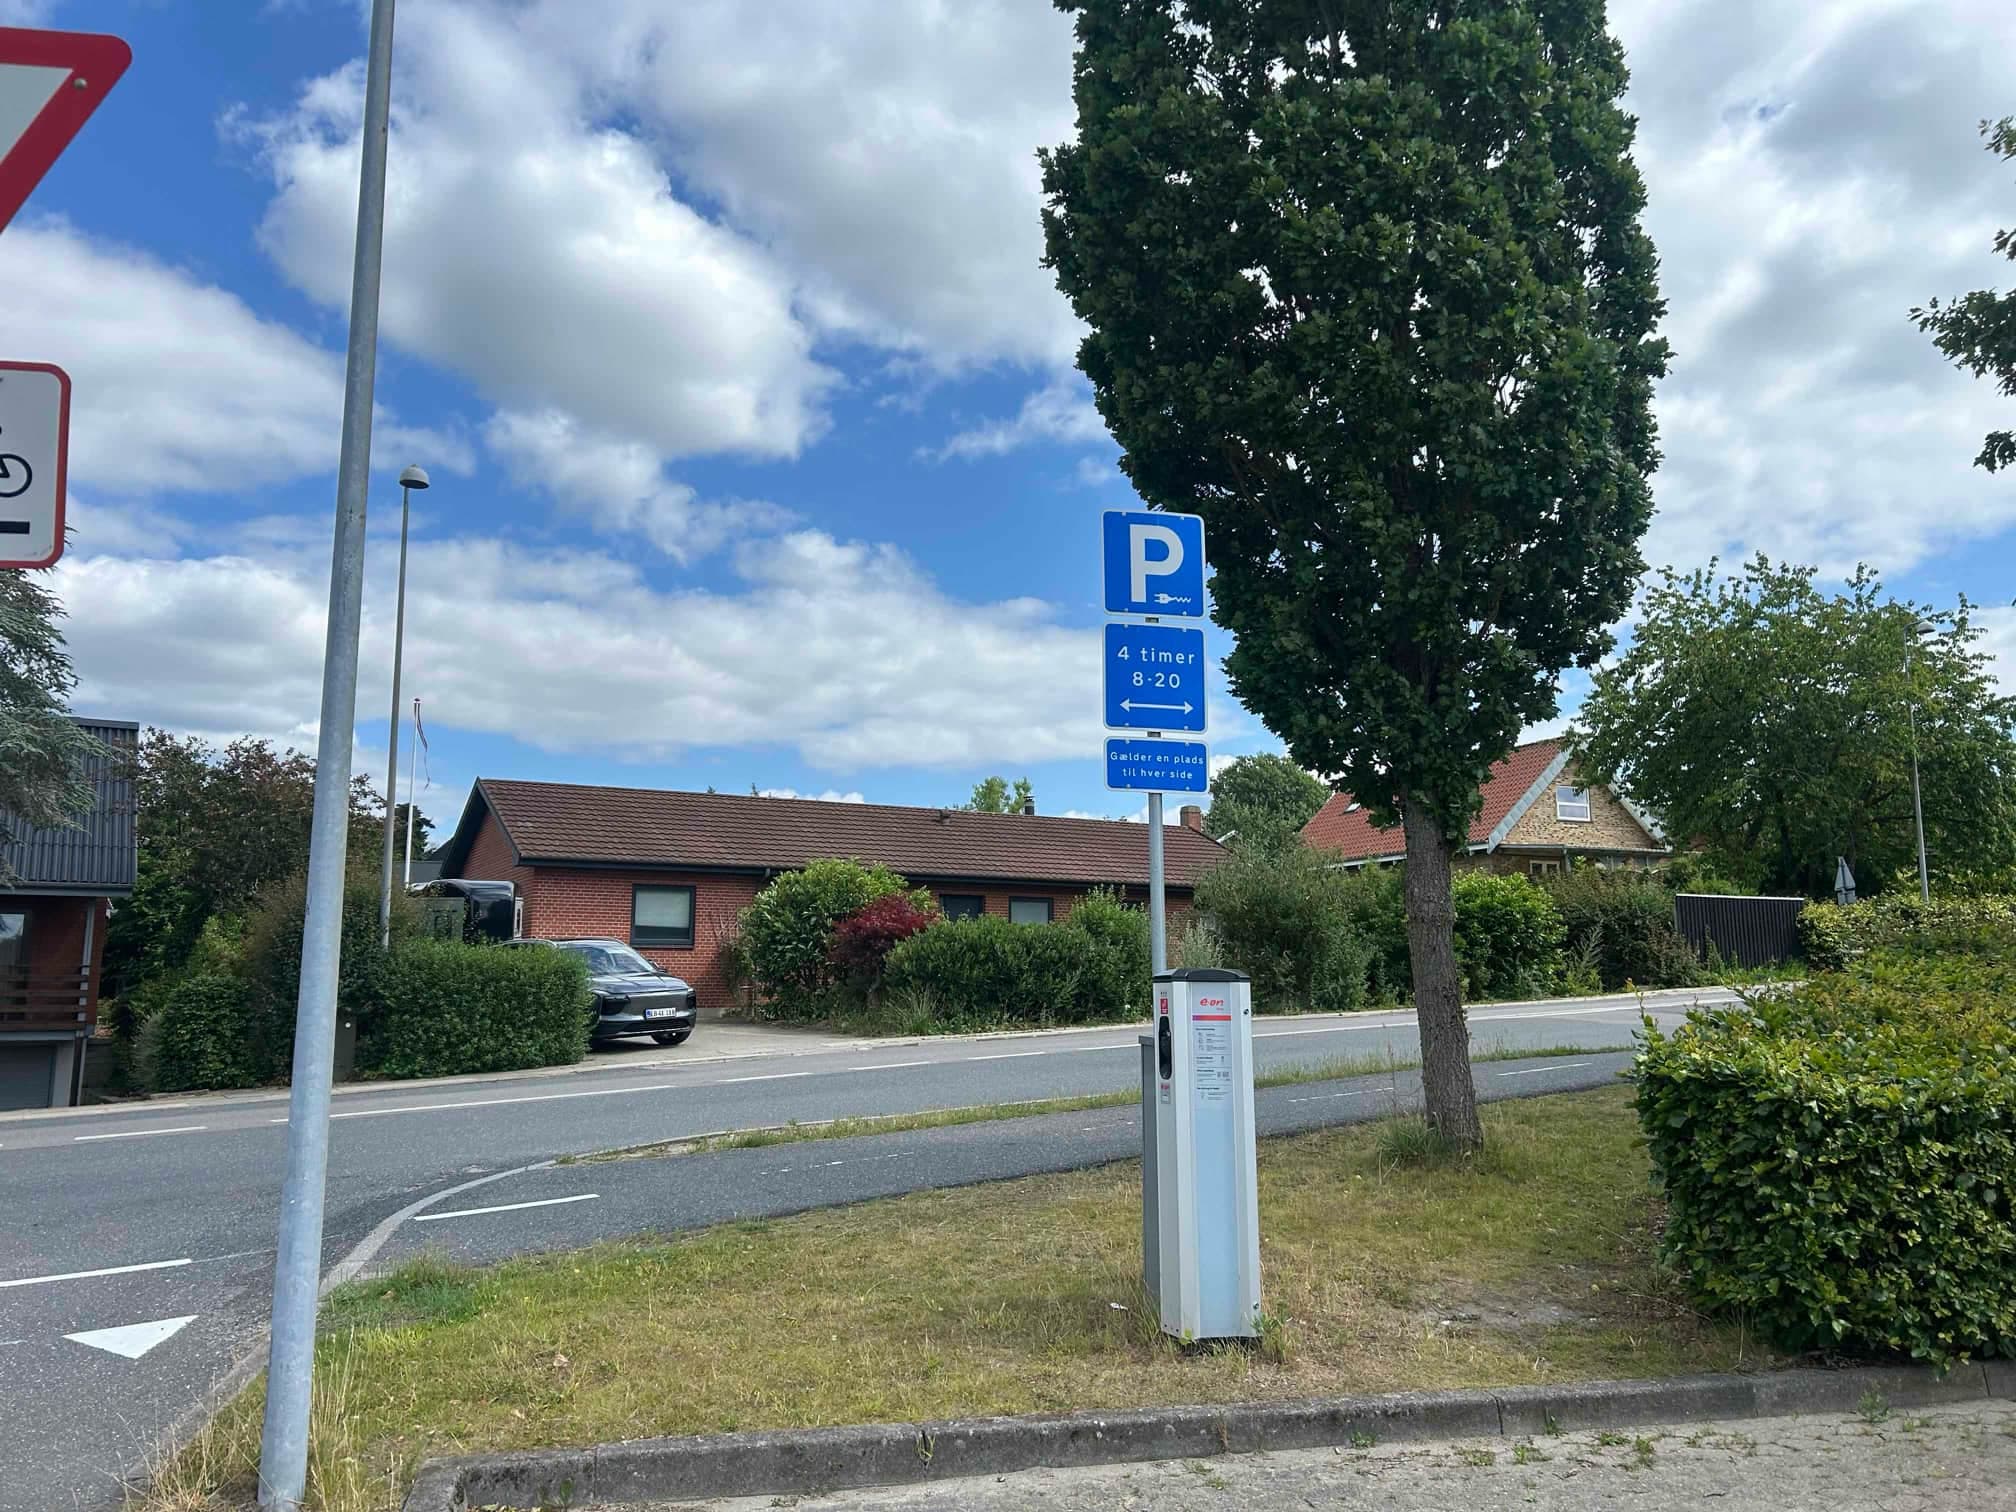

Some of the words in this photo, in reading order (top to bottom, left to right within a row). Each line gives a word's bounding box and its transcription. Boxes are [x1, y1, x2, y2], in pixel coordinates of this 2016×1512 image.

[1129, 523, 1184, 604] P
[1117, 645, 1130, 661] 4
[1140, 647, 1195, 665] timer
[1110, 751, 1151, 761] Gælder
[1156, 754, 1169, 763] en
[1174, 754, 1204, 765] plads
[1122, 767, 1136, 777] til
[1140, 767, 1165, 778] hver
[1169, 769, 1193, 780] side
